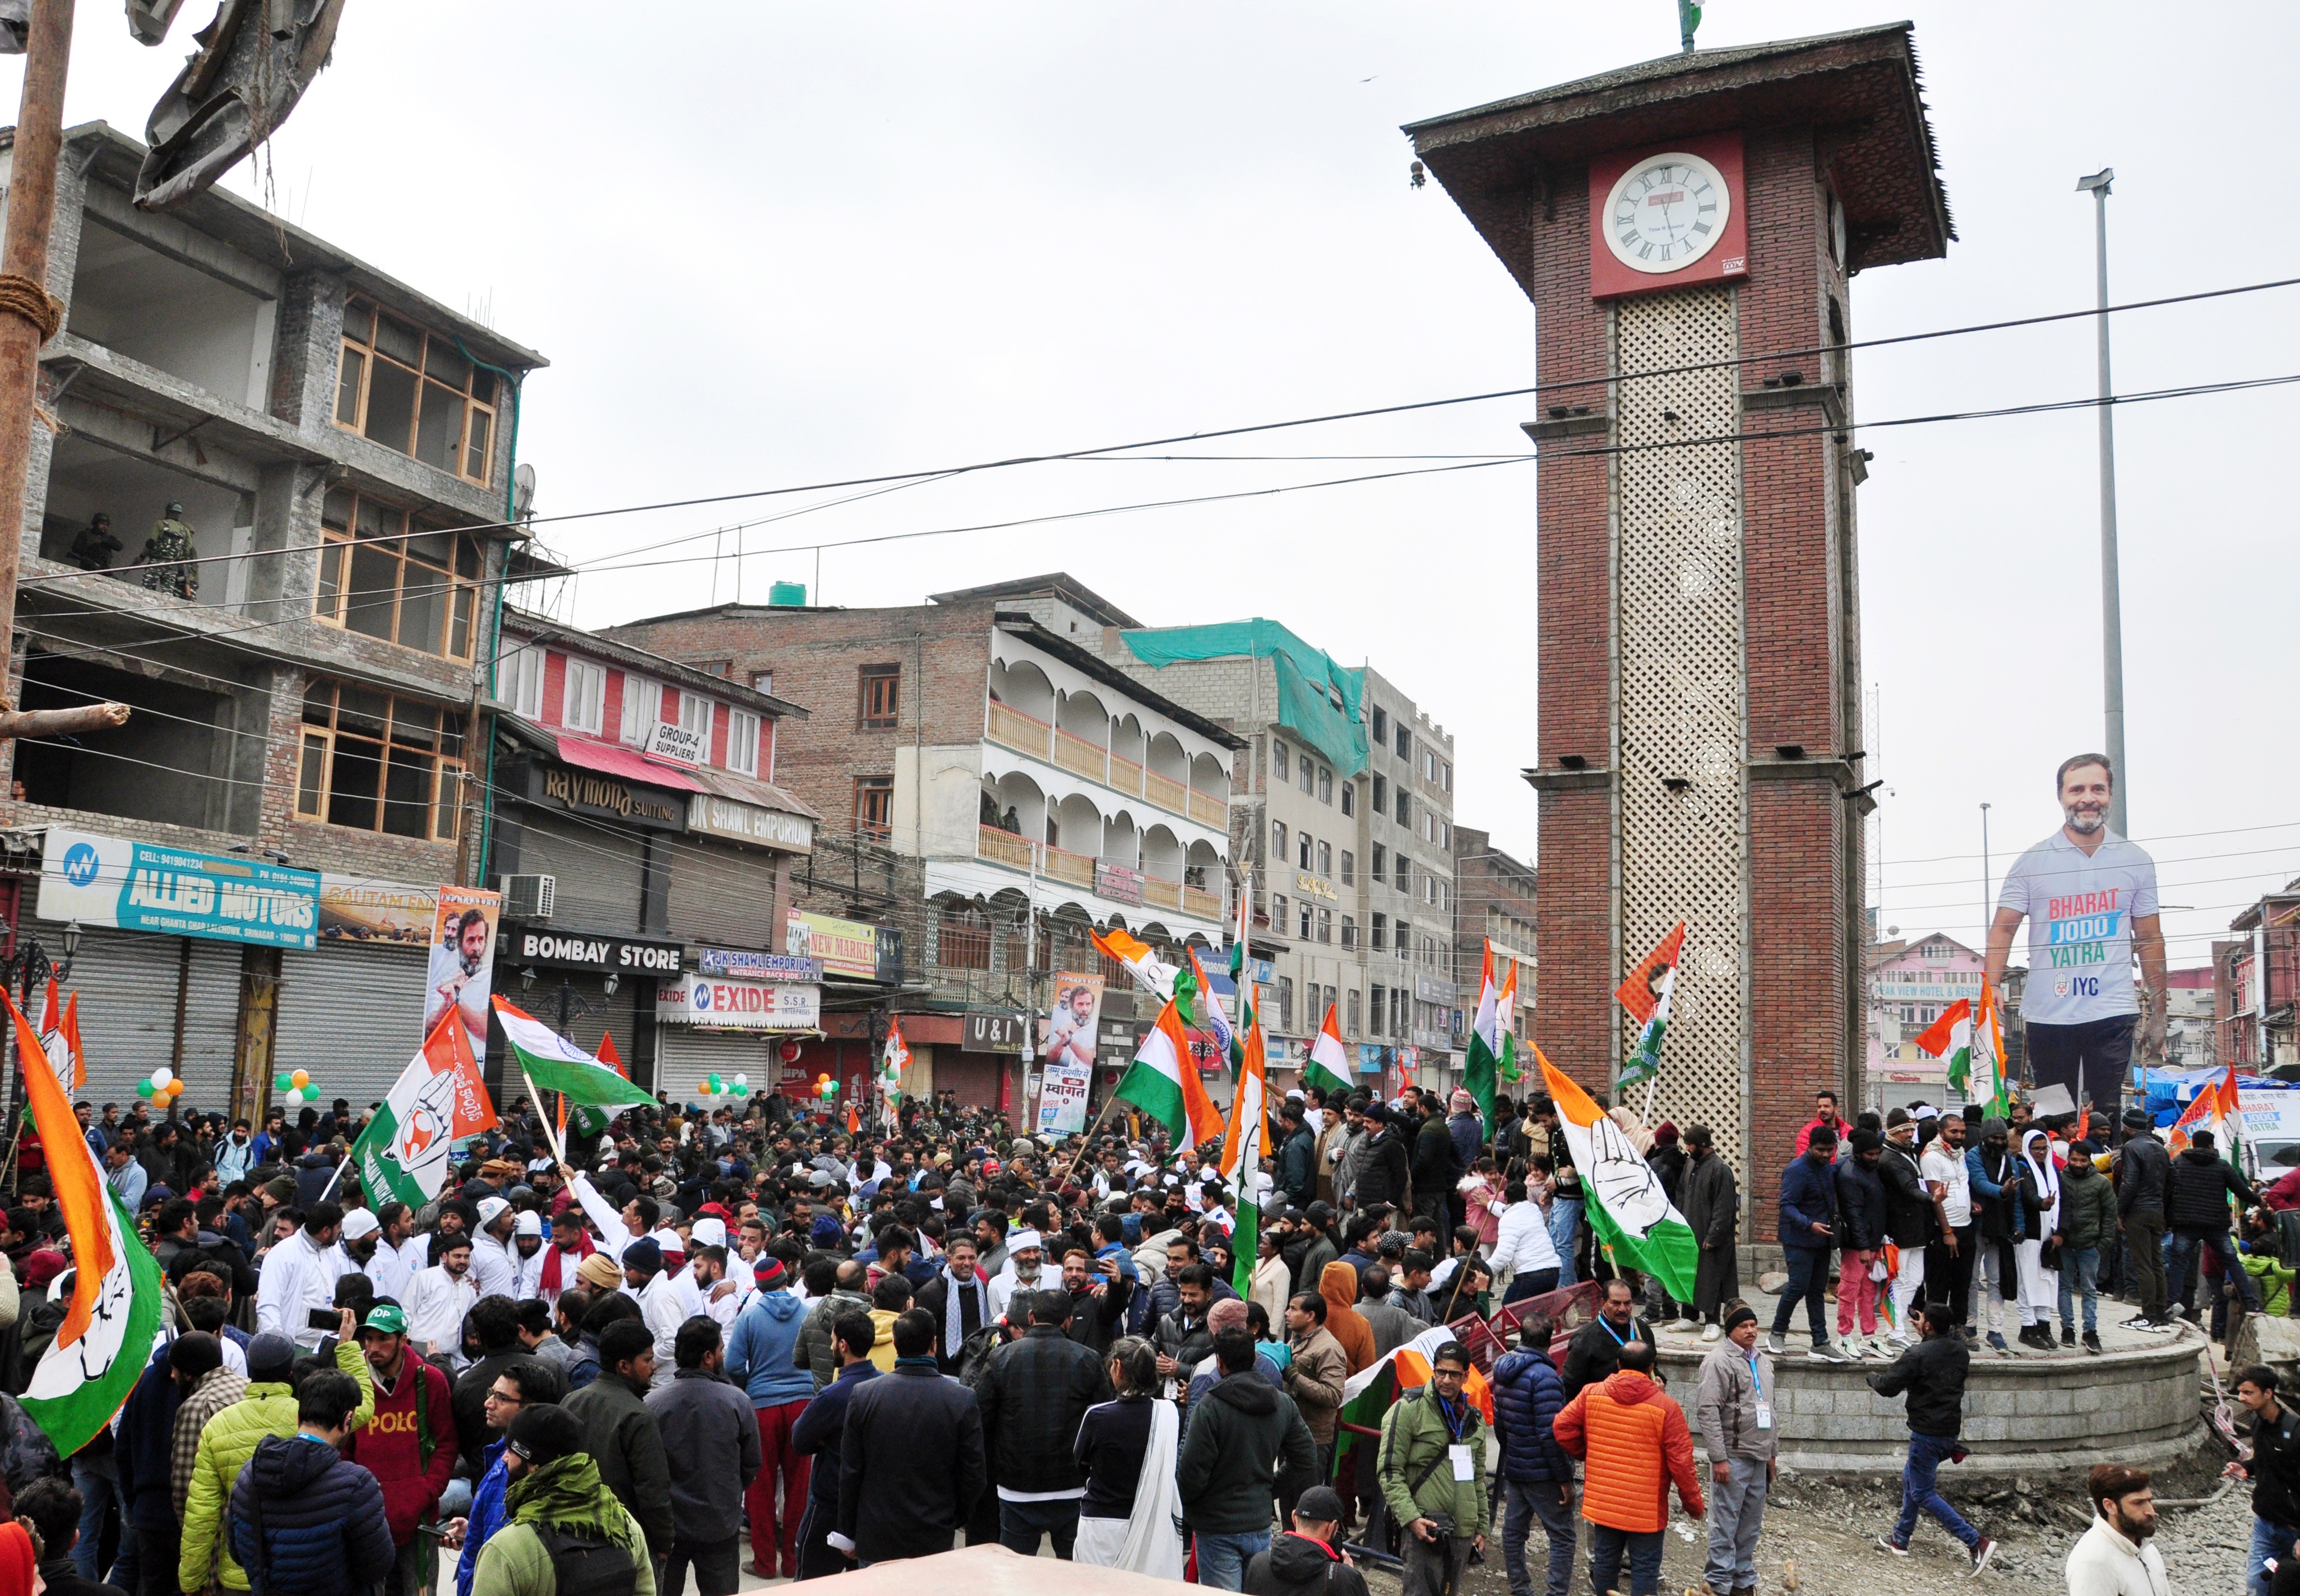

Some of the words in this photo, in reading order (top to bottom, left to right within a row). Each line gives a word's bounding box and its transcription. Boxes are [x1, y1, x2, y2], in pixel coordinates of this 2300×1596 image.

[1636, 174, 1655, 194] XI
[659, 725, 700, 748] GROUP-4
[655, 741, 696, 761] SUPPLIERS
[634, 800, 674, 820] SUITING
[688, 794, 707, 829] JK
[712, 802, 751, 835] SHAWL
[754, 811, 812, 848] EMPORIUM
[140, 850, 159, 864] CELL:
[160, 854, 203, 870] 9419041234
[129, 869, 215, 915] ALLIED
[220, 881, 314, 929] MOTORS
[328, 886, 402, 911] GAUTAM
[2049, 888, 2119, 920] BHARAT
[141, 915, 159, 925] NEAR
[160, 917, 186, 929] GHANTA
[244, 927, 274, 940] SRINAGAR
[2056, 916, 2108, 943] JODO
[524, 935, 610, 963] BOMBAY
[619, 945, 679, 970] STORE
[811, 932, 832, 954] NEW
[835, 936, 874, 962] MARKET
[2050, 941, 2105, 968] YATRA
[716, 952, 728, 966] JK
[732, 953, 763, 968] SHAWL
[766, 956, 812, 972] EMPORIUM
[1197, 956, 1232, 976] Panasonic
[729, 968, 765, 978] ENTRANCE
[766, 971, 785, 979] BACK
[659, 989, 685, 1003] EXIDE
[1260, 987, 1271, 999] NY
[1876, 986, 1895, 996] PEAK
[1898, 986, 1918, 996] VIEW
[1920, 987, 1944, 997] HOTEL
[1947, 987, 1952, 996] &
[1956, 988, 2006, 998] RESTAT
[2073, 977, 2098, 996] IYC
[713, 985, 775, 1013] EXIDE
[784, 996, 808, 1007] S.S.R.
[975, 1018, 986, 1040] U
[990, 1019, 1001, 1041] &
[1006, 1020, 1011, 1042] I
[781, 1069, 807, 1079] UPA
[1046, 1066, 1060, 1077] जम्मू
[1061, 1068, 1082, 1077] कश्मीर
[1045, 1083, 1086, 1098] स्वागत
[1043, 1108, 1054, 1117] जोड़ो
[2239, 1103, 2276, 1112] BHARAT
[2247, 1113, 2275, 1122] JODO
[2247, 1122, 2280, 1132] YATRA
[369, 1308, 391, 1319] PDP
[368, 1411, 417, 1436] POLO
